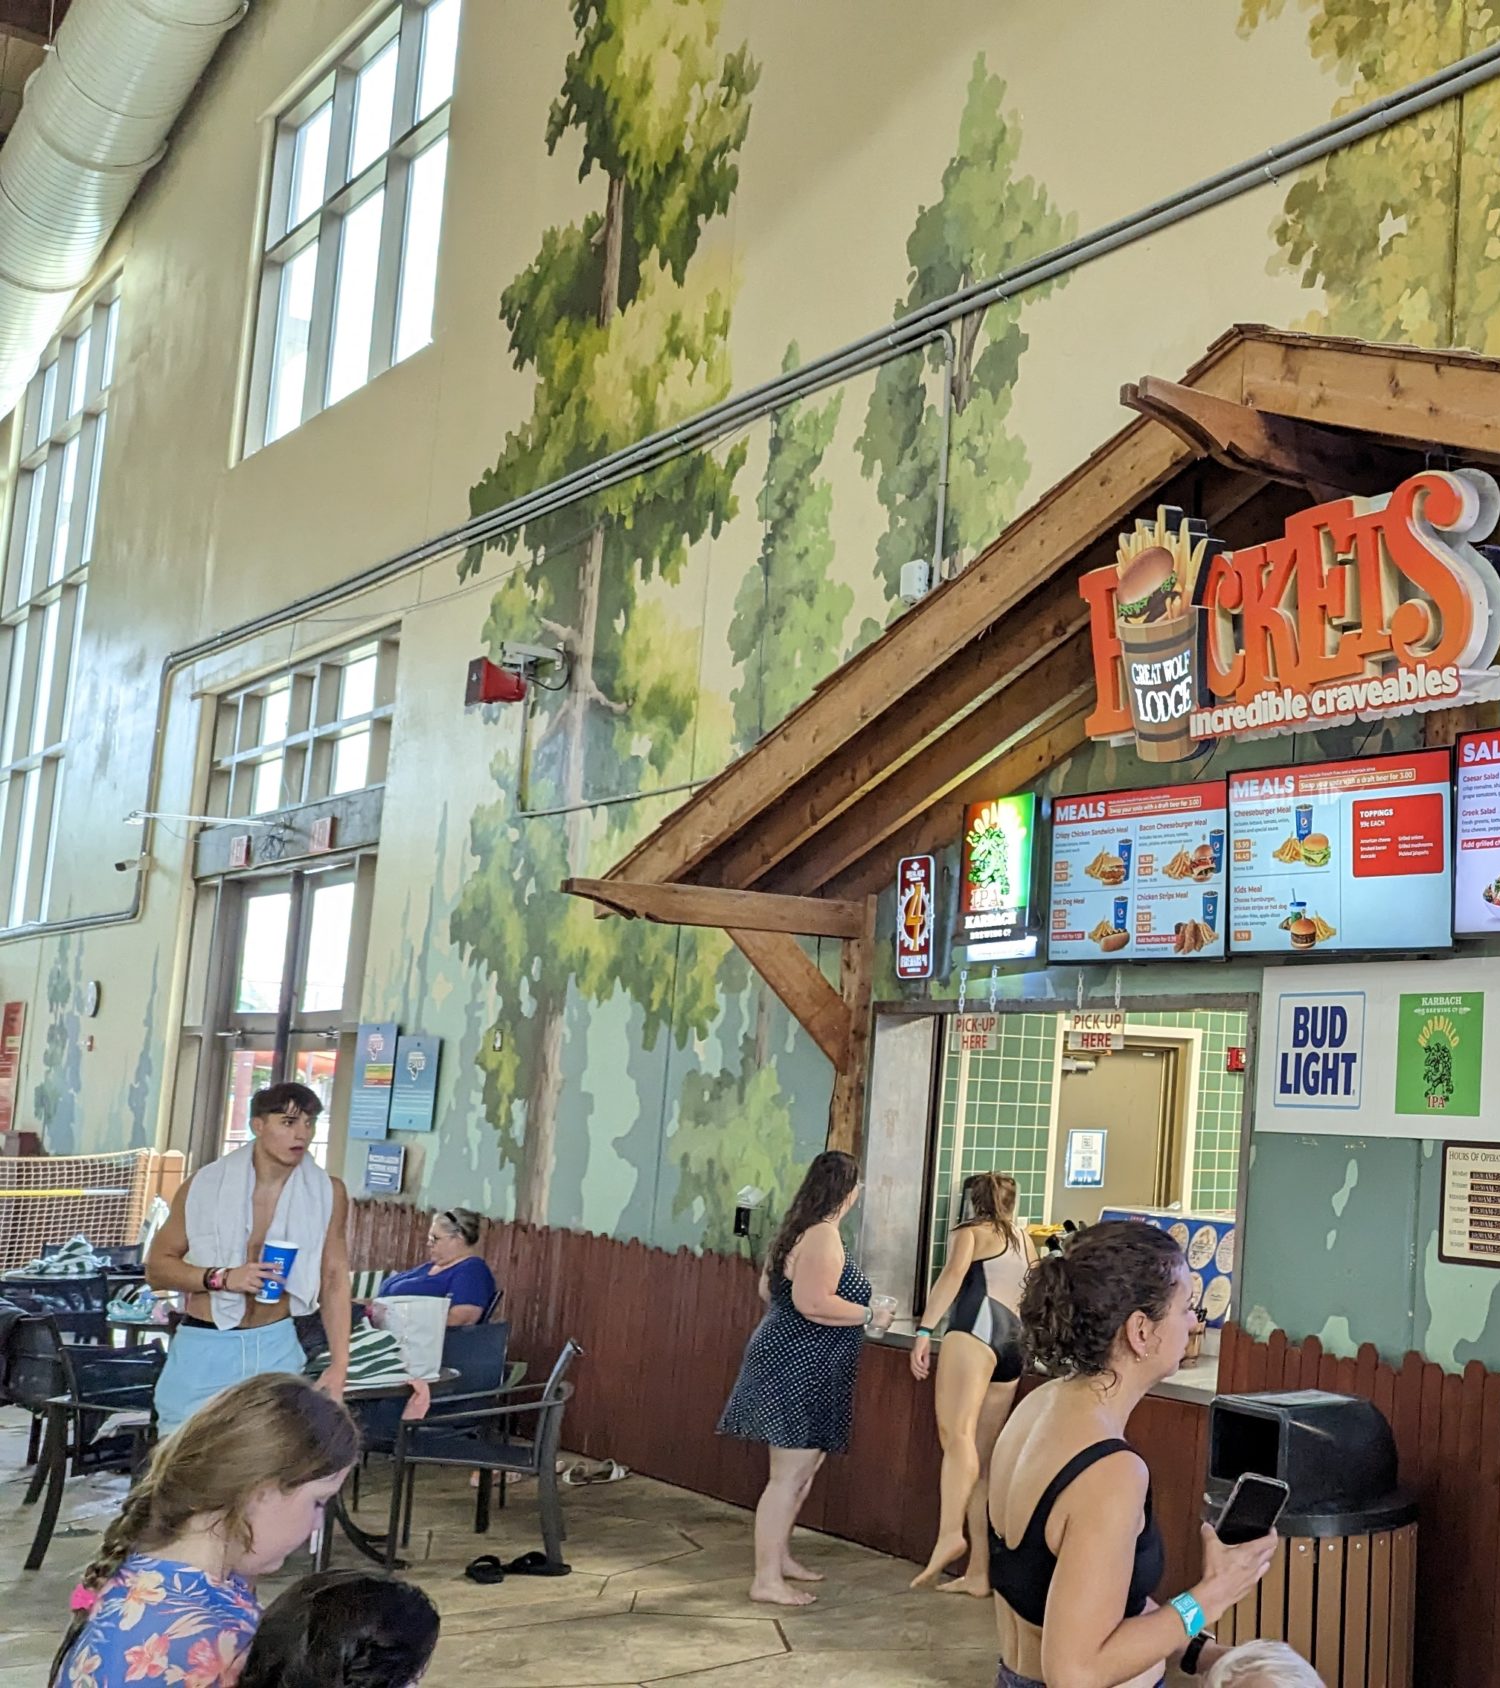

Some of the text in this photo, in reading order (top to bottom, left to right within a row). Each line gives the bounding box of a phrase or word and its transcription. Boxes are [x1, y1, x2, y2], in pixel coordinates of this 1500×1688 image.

[1079, 469, 1484, 736] CKETS
[1132, 649, 1190, 685] GREAT WOLF
[1135, 676, 1192, 723] LODGE
[1190, 666, 1458, 737] incredible craveables
[1463, 774, 1482, 782] Caesar
[1484, 772, 1499, 780] Salad
[1233, 776, 1294, 798] MEALS
[1056, 801, 1105, 821] MEALS
[1360, 809, 1393, 818] TOPPINGS
[1476, 839, 1493, 848] grilled
[971, 889, 1000, 909] IPA
[1422, 997, 1461, 1005] KARBACH
[956, 1016, 996, 1033] PICK-UP
[1073, 1014, 1121, 1029] PICK-UP
[1293, 1006, 1348, 1049] BUD
[962, 1036, 987, 1049] HERE
[1081, 1033, 1112, 1048] HERE
[1280, 1052, 1357, 1096] LIGHT
[1427, 1096, 1445, 1108] IPA
